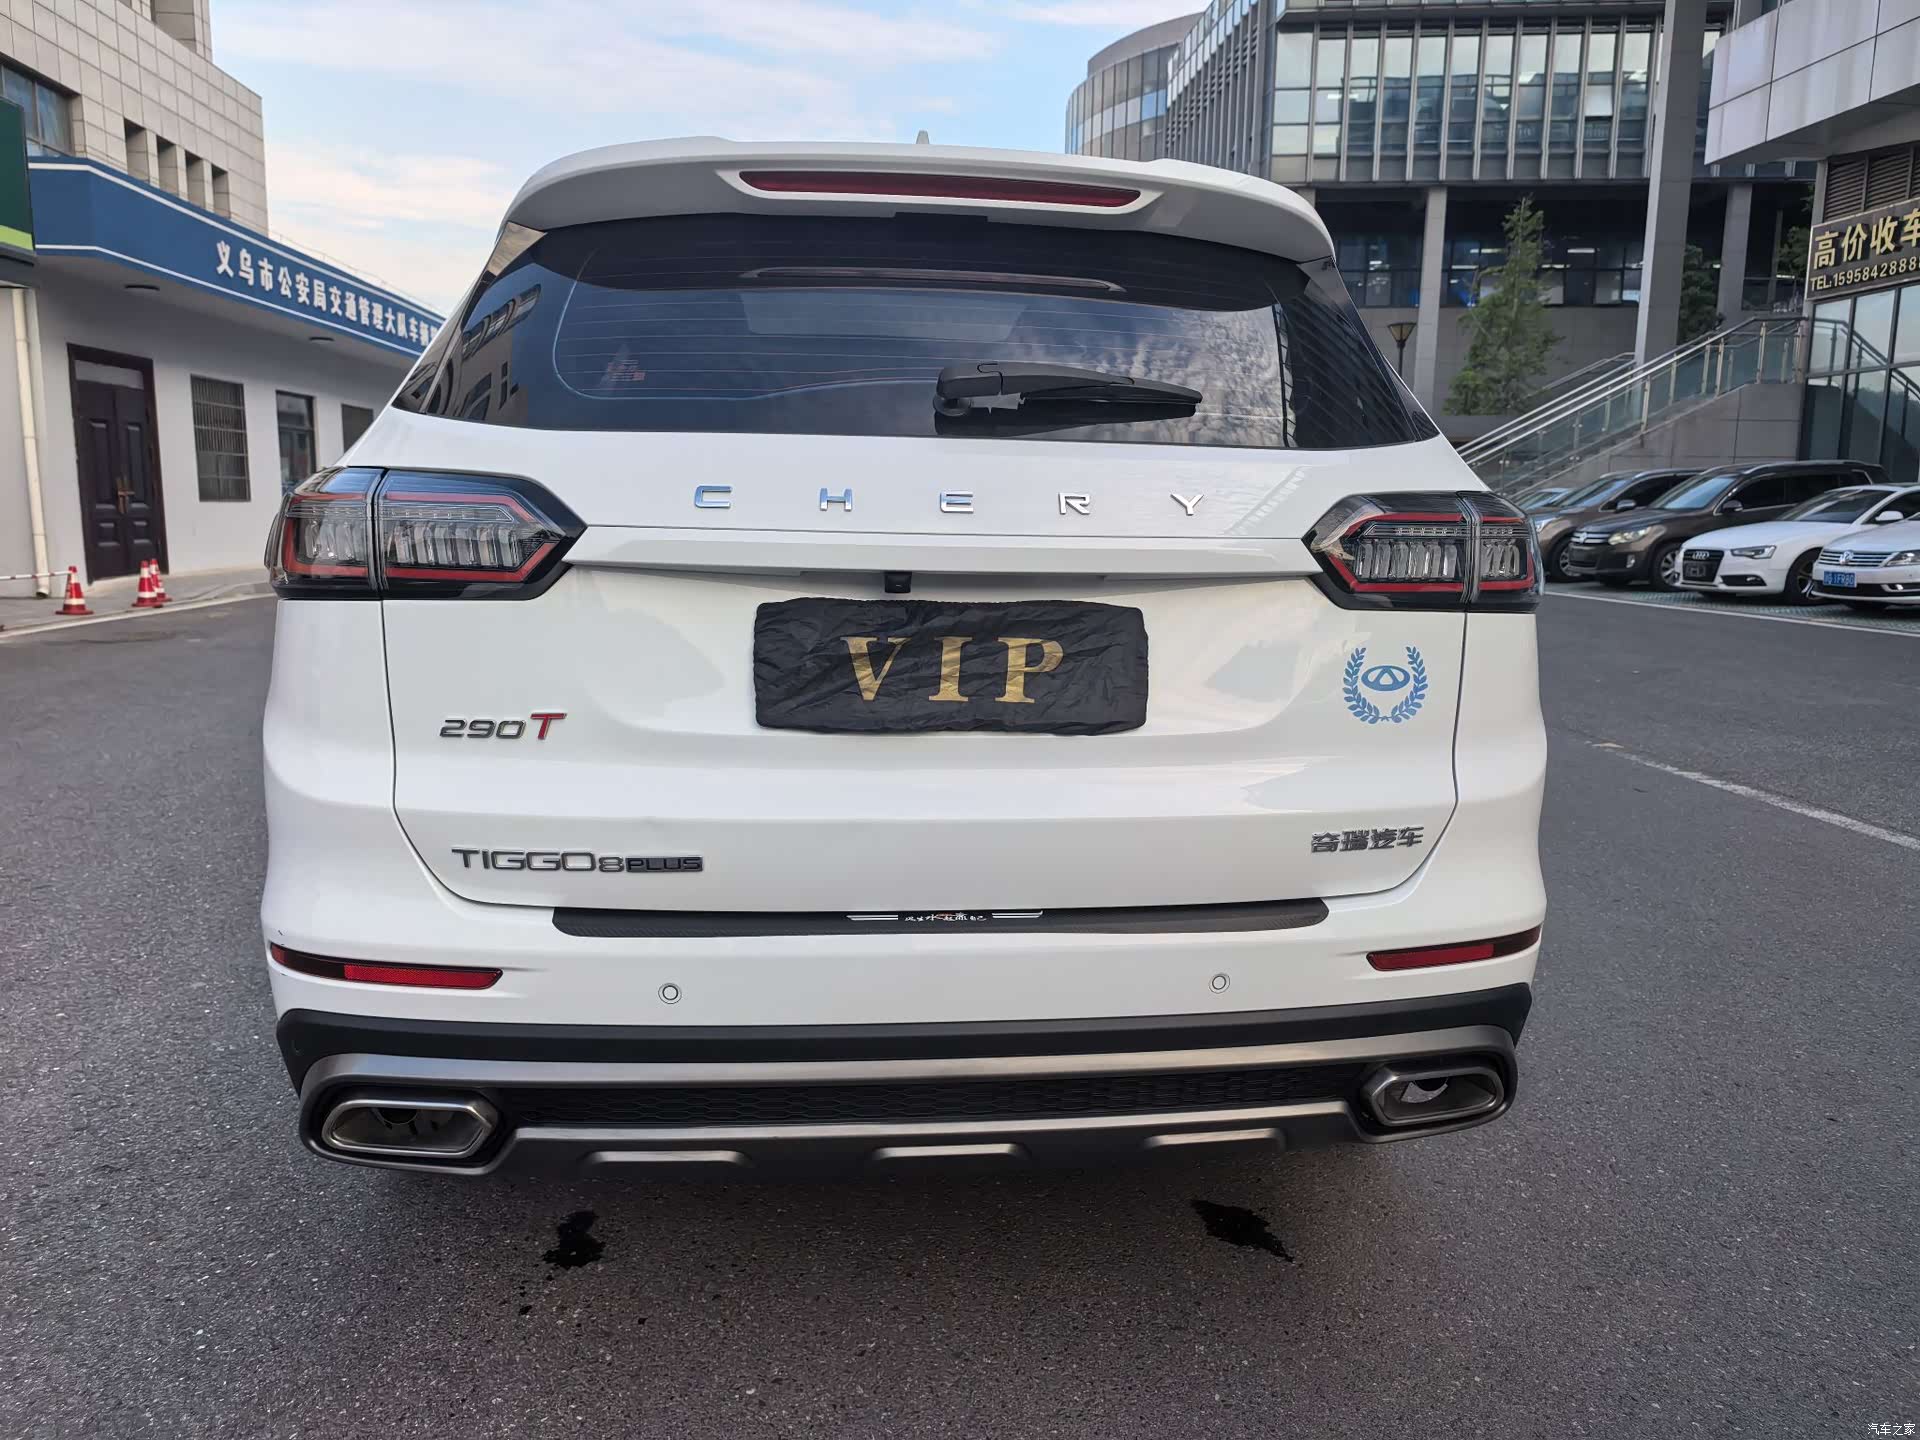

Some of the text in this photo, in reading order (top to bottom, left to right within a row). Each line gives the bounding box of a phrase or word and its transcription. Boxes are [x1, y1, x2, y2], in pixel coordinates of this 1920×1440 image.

[1813, 207, 1920, 270] 高价收车
[694, 485, 1205, 516] CHERY
[840, 636, 1064, 704] VIP
[439, 712, 567, 740] 290T
[1311, 826, 1424, 853] 奇瑞汽车
